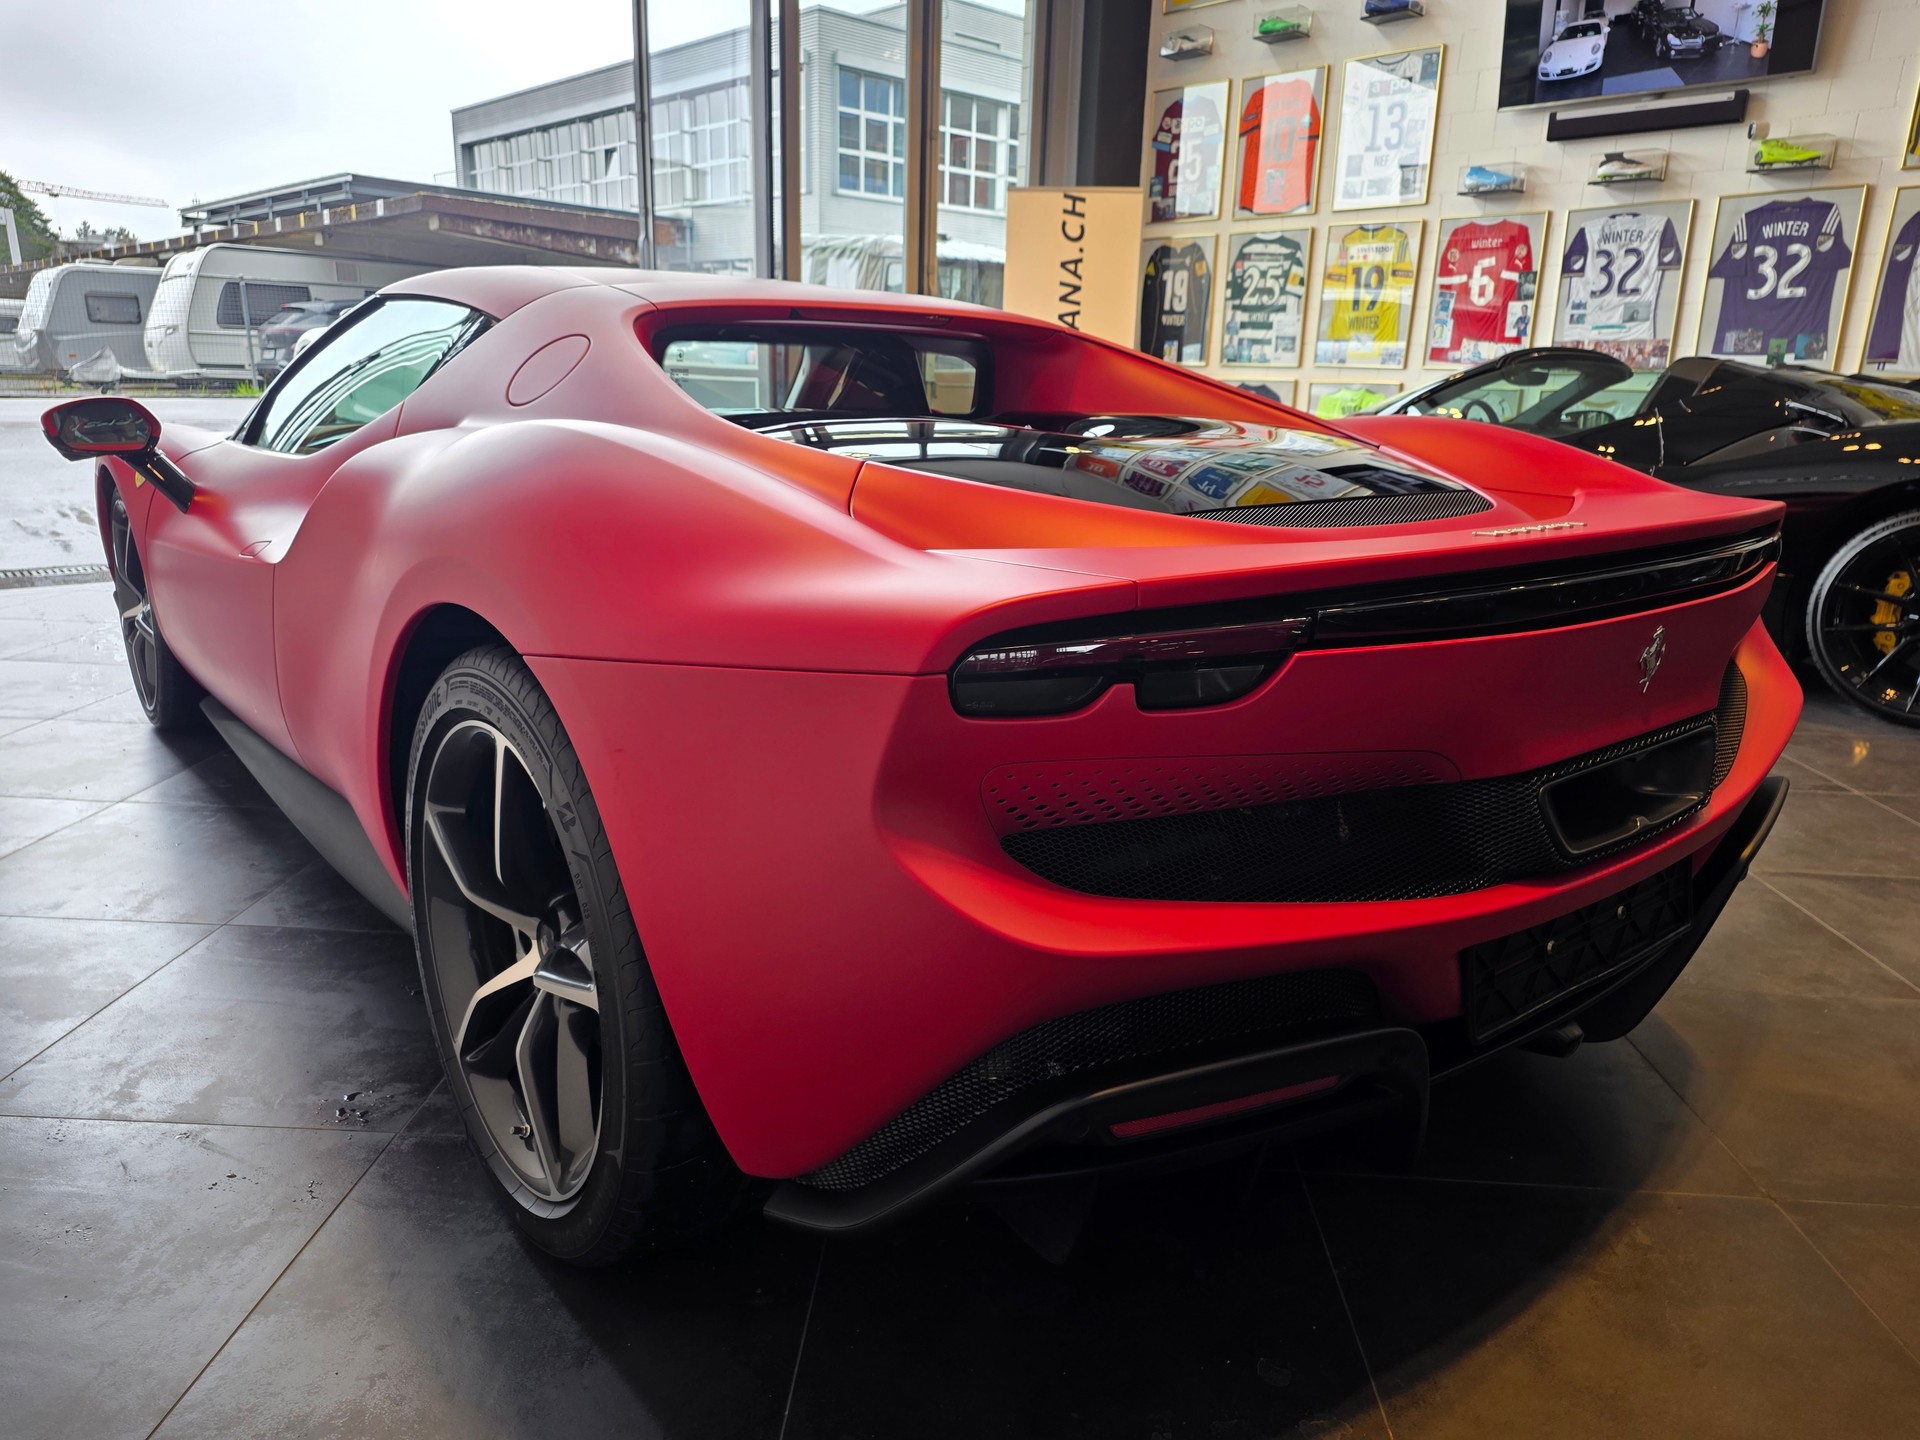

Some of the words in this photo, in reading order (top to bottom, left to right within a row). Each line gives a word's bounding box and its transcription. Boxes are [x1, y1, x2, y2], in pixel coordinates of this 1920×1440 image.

[1364, 101, 1408, 152] 13
[1471, 238, 1504, 250] winter
[1602, 229, 1644, 245] WINTER
[1763, 221, 1810, 239] WINTER
[1059, 192, 1086, 331] ANA.CH
[1469, 256, 1496, 307] 6
[1590, 248, 1646, 299] 32
[1747, 243, 1812, 300] 32
[1162, 270, 1189, 312] 19
[1241, 265, 1283, 306] 25
[1352, 265, 1385, 312] 19
[1348, 315, 1380, 331] WINTER
